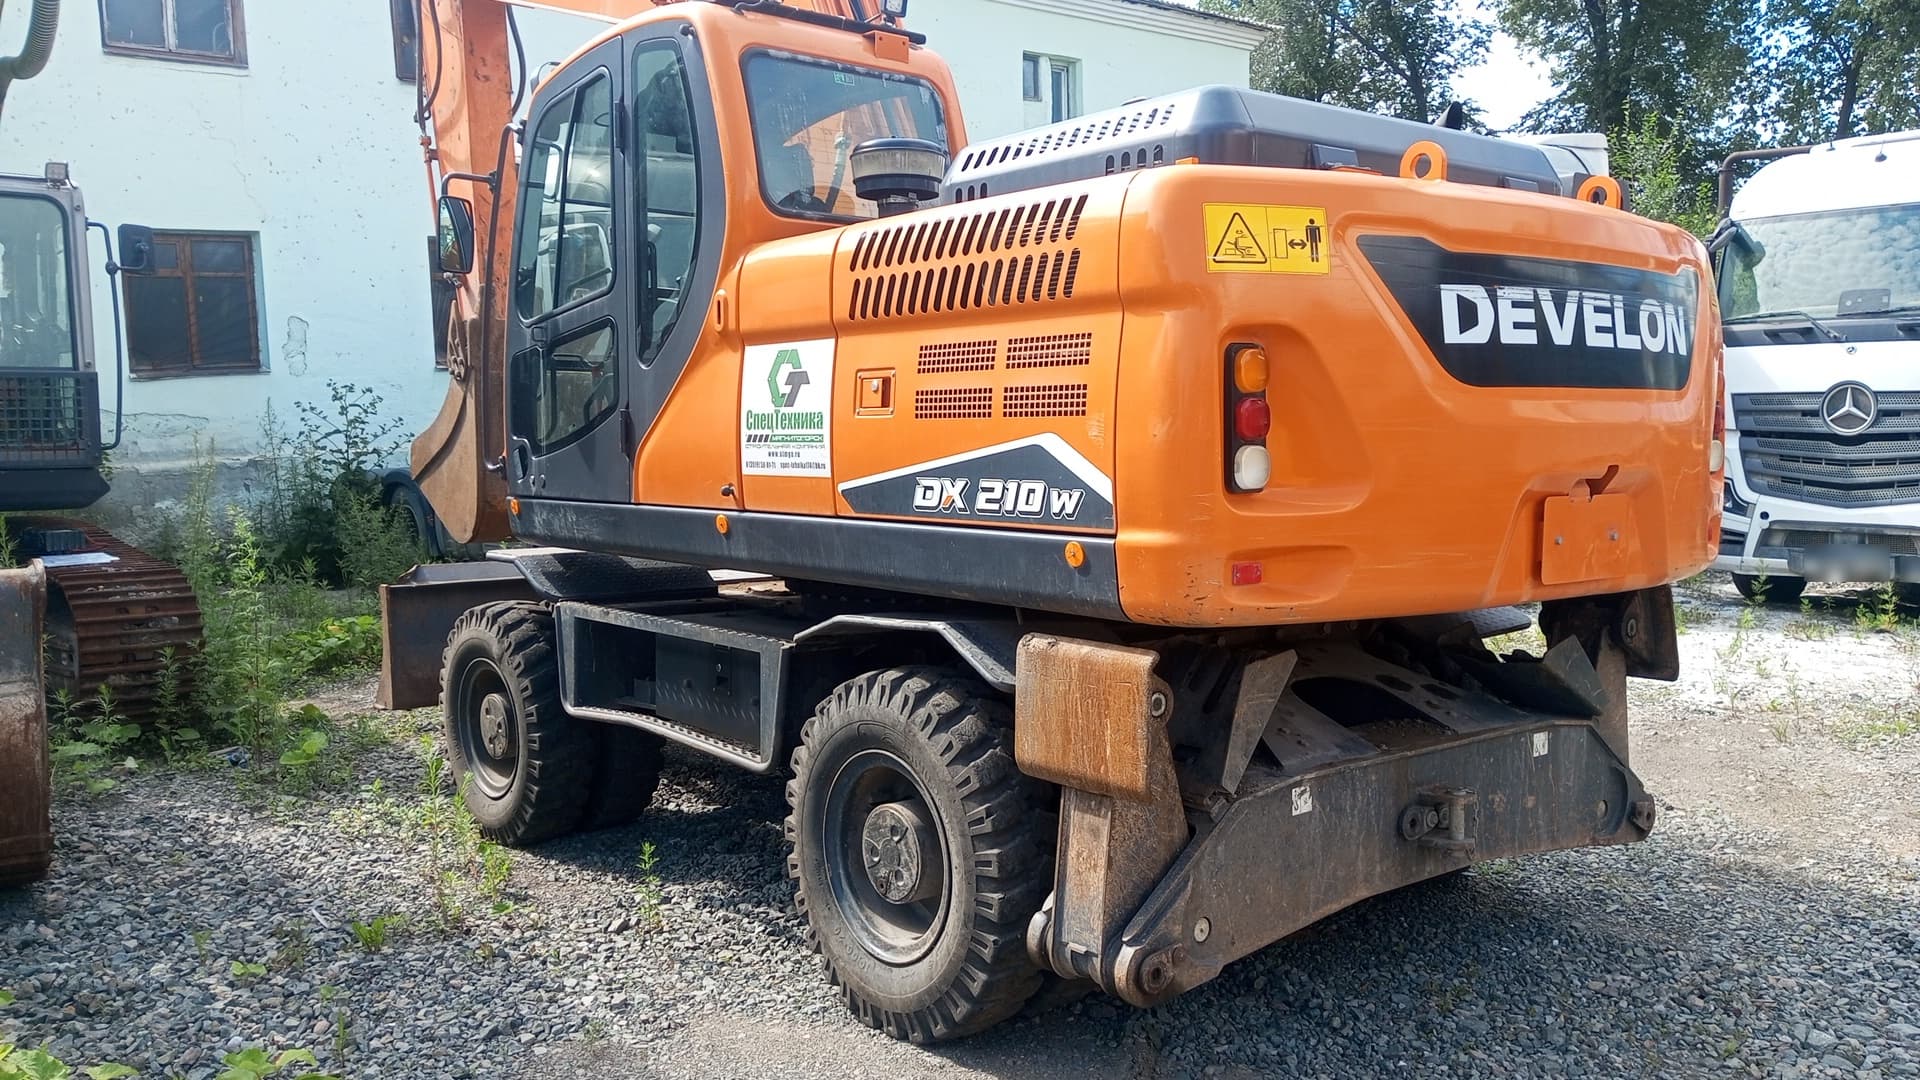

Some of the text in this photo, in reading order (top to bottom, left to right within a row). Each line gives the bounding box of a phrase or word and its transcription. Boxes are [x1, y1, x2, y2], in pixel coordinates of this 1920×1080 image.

[1439, 283, 1688, 356] DEVELON
[746, 409, 824, 433] СпецТехника
[914, 477, 970, 514] DX
